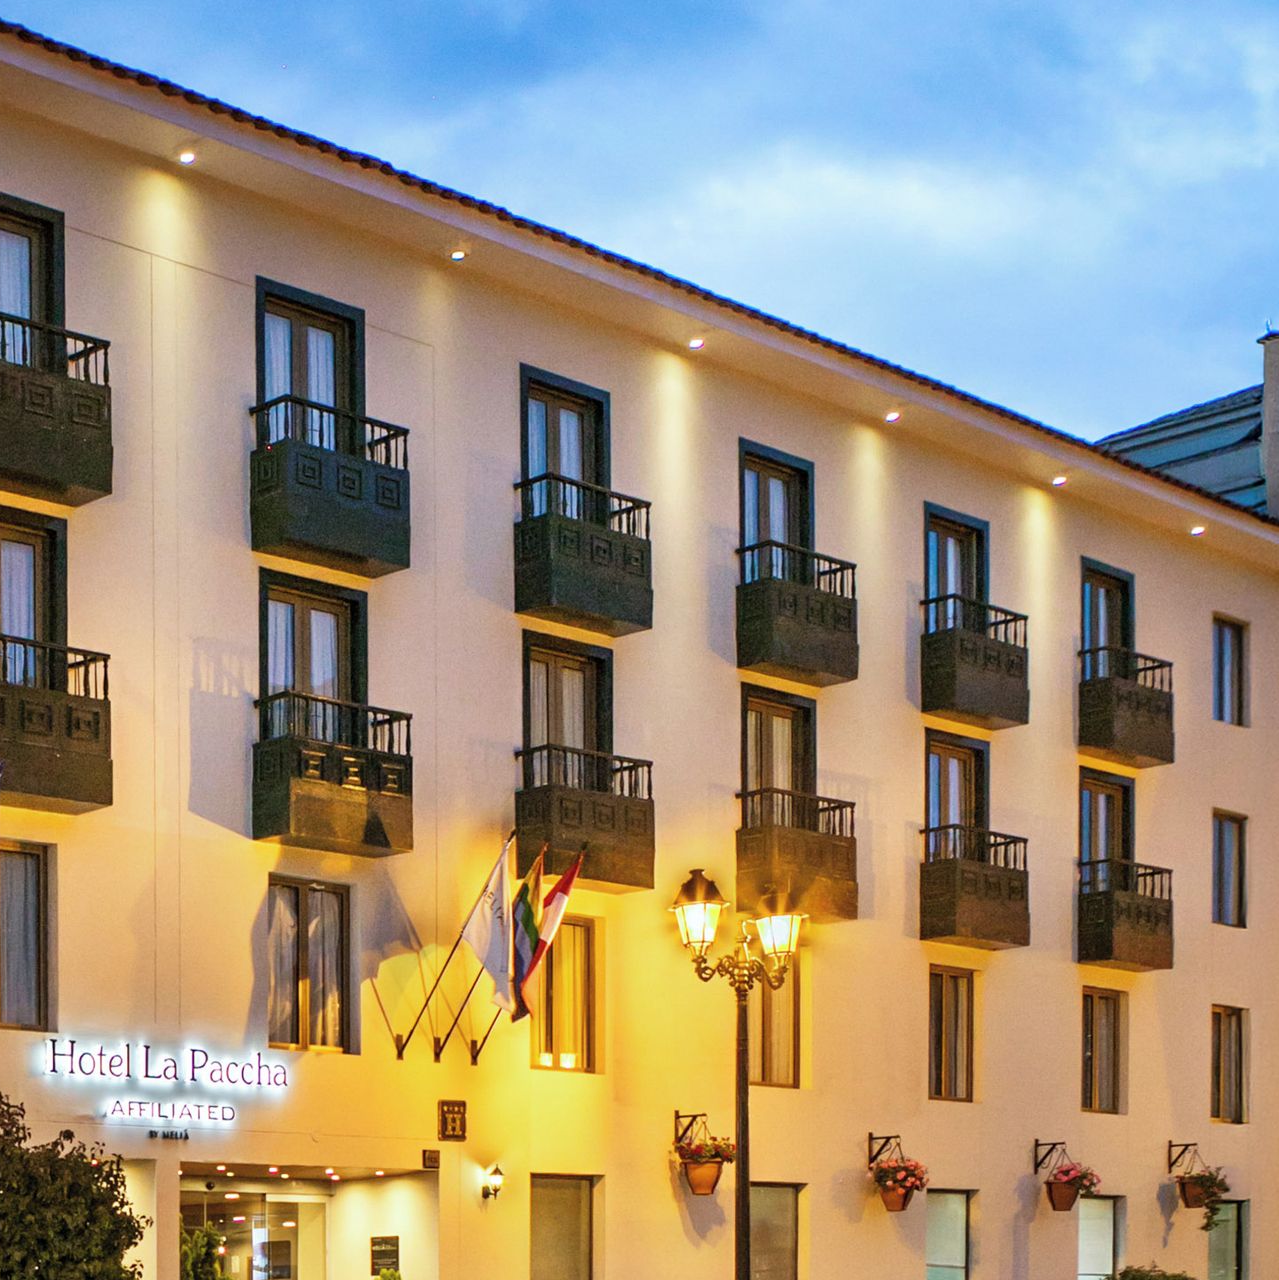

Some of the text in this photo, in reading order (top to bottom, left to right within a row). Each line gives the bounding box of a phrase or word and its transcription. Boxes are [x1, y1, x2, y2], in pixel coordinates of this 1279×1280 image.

[49, 1038, 288, 1087] Hotel La Paccha
[111, 1100, 236, 1121] AFFILIATED
[148, 1129, 159, 1139] BY
